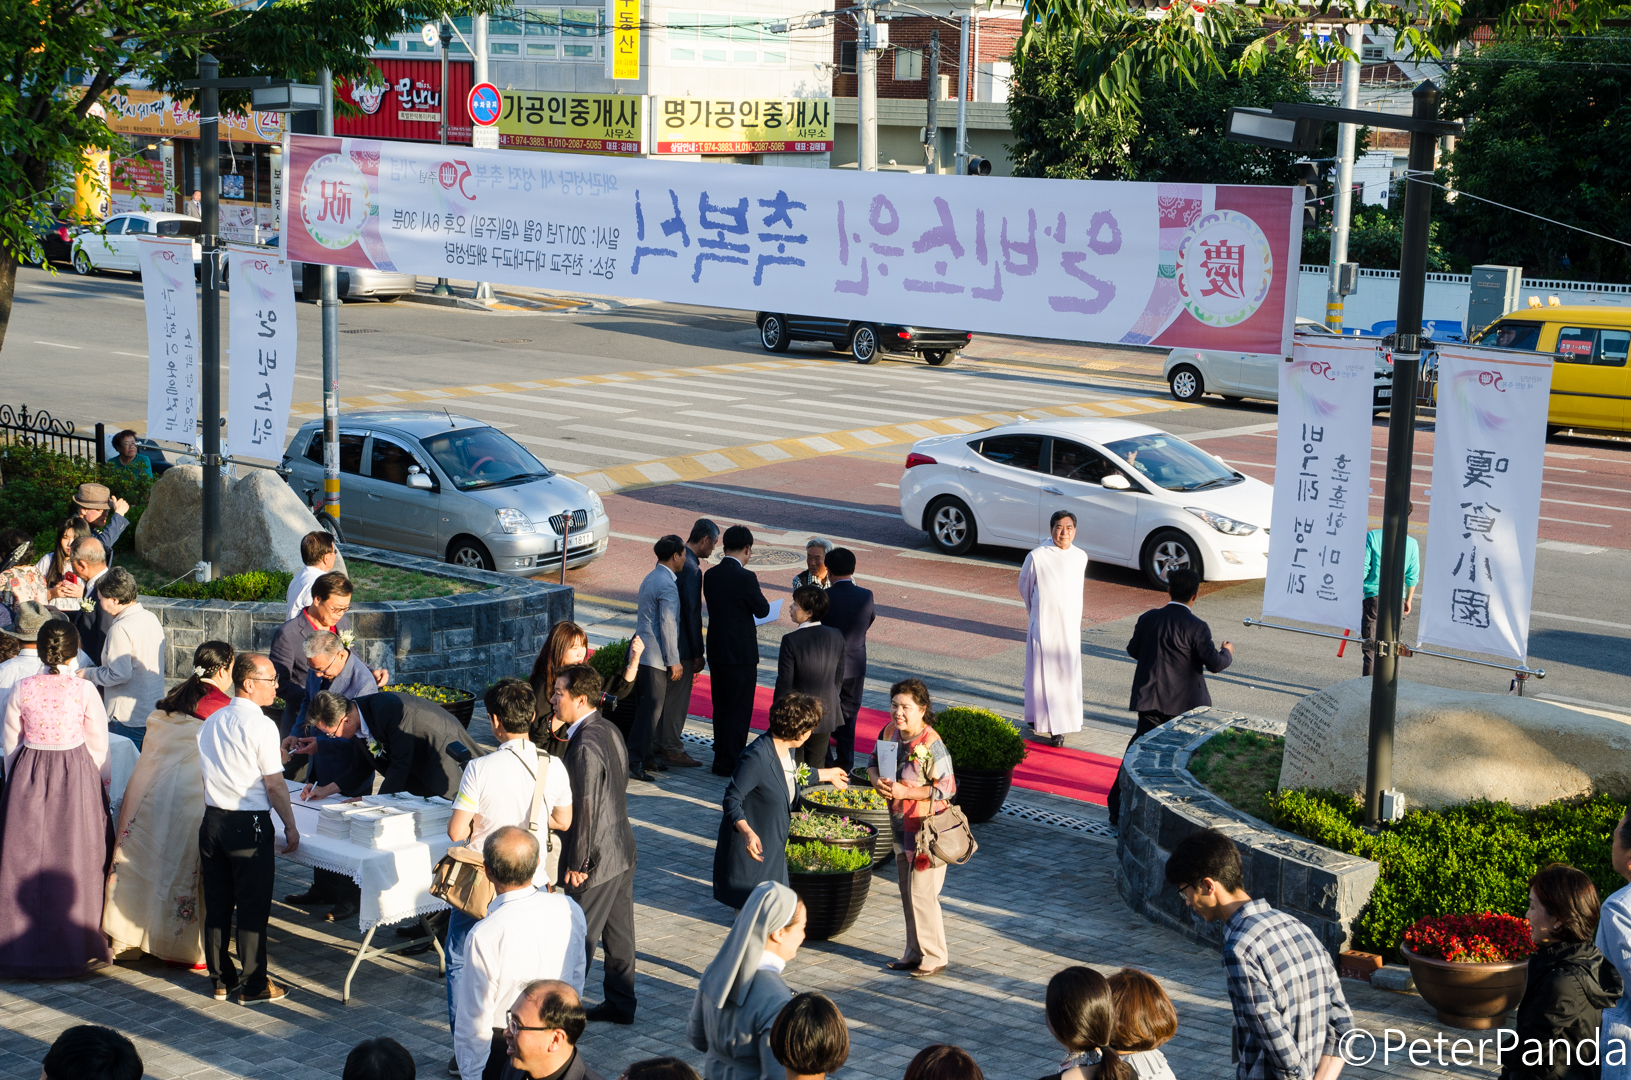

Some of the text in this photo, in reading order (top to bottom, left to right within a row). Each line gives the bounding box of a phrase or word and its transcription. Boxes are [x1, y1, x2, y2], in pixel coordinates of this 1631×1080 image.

[473, 100, 498, 109] 주차금지
[504, 95, 638, 128] 가공인중개사
[664, 100, 830, 128] 명가공인중개사
[604, 128, 634, 139] 사무소
[797, 129, 826, 138] 사무소
